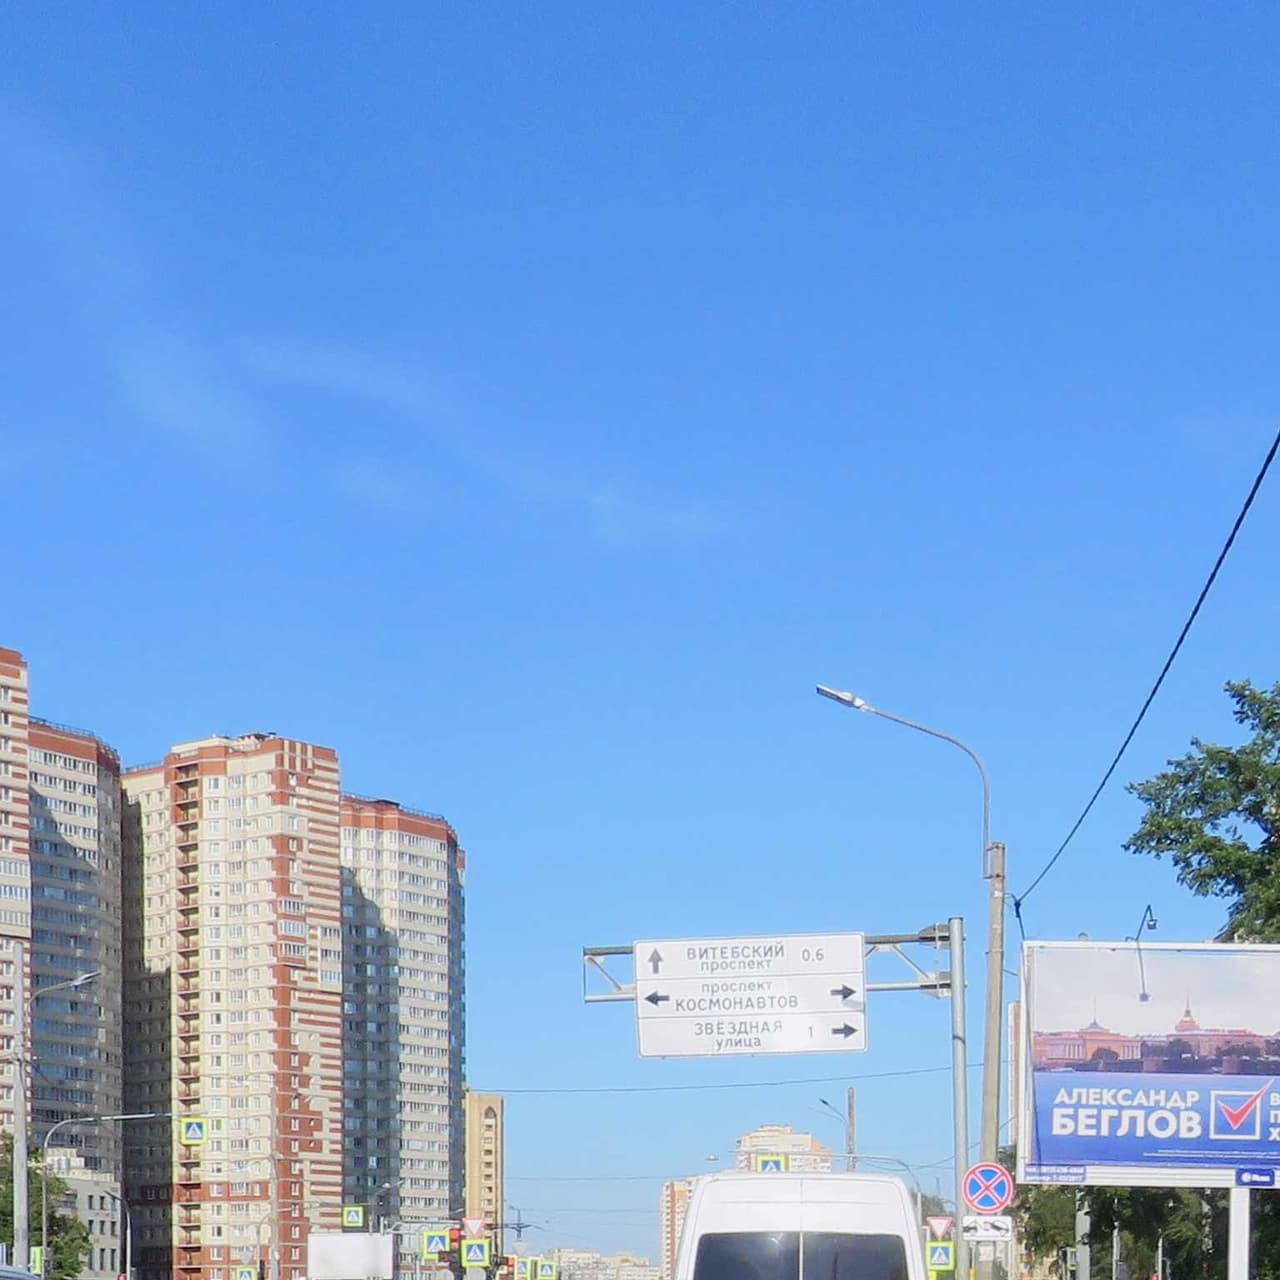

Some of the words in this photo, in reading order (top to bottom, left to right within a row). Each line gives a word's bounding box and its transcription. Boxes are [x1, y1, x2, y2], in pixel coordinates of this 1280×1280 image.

[686, 941, 785, 961] ВИТЕБСКИЙ
[801, 948, 824, 962] 0.6
[700, 959, 773, 973] проспект
[701, 981, 773, 995] проспект
[675, 995, 799, 1012] КОСМОНАВТОВ
[694, 1020, 783, 1036] ЗВЁЗДНАЯ
[808, 1026, 813, 1038] 1
[715, 1036, 761, 1050] улица
[1053, 1087, 1201, 1109] АЛЕКСАНДР
[1051, 1107, 1203, 1139] БЕГЛОВ
